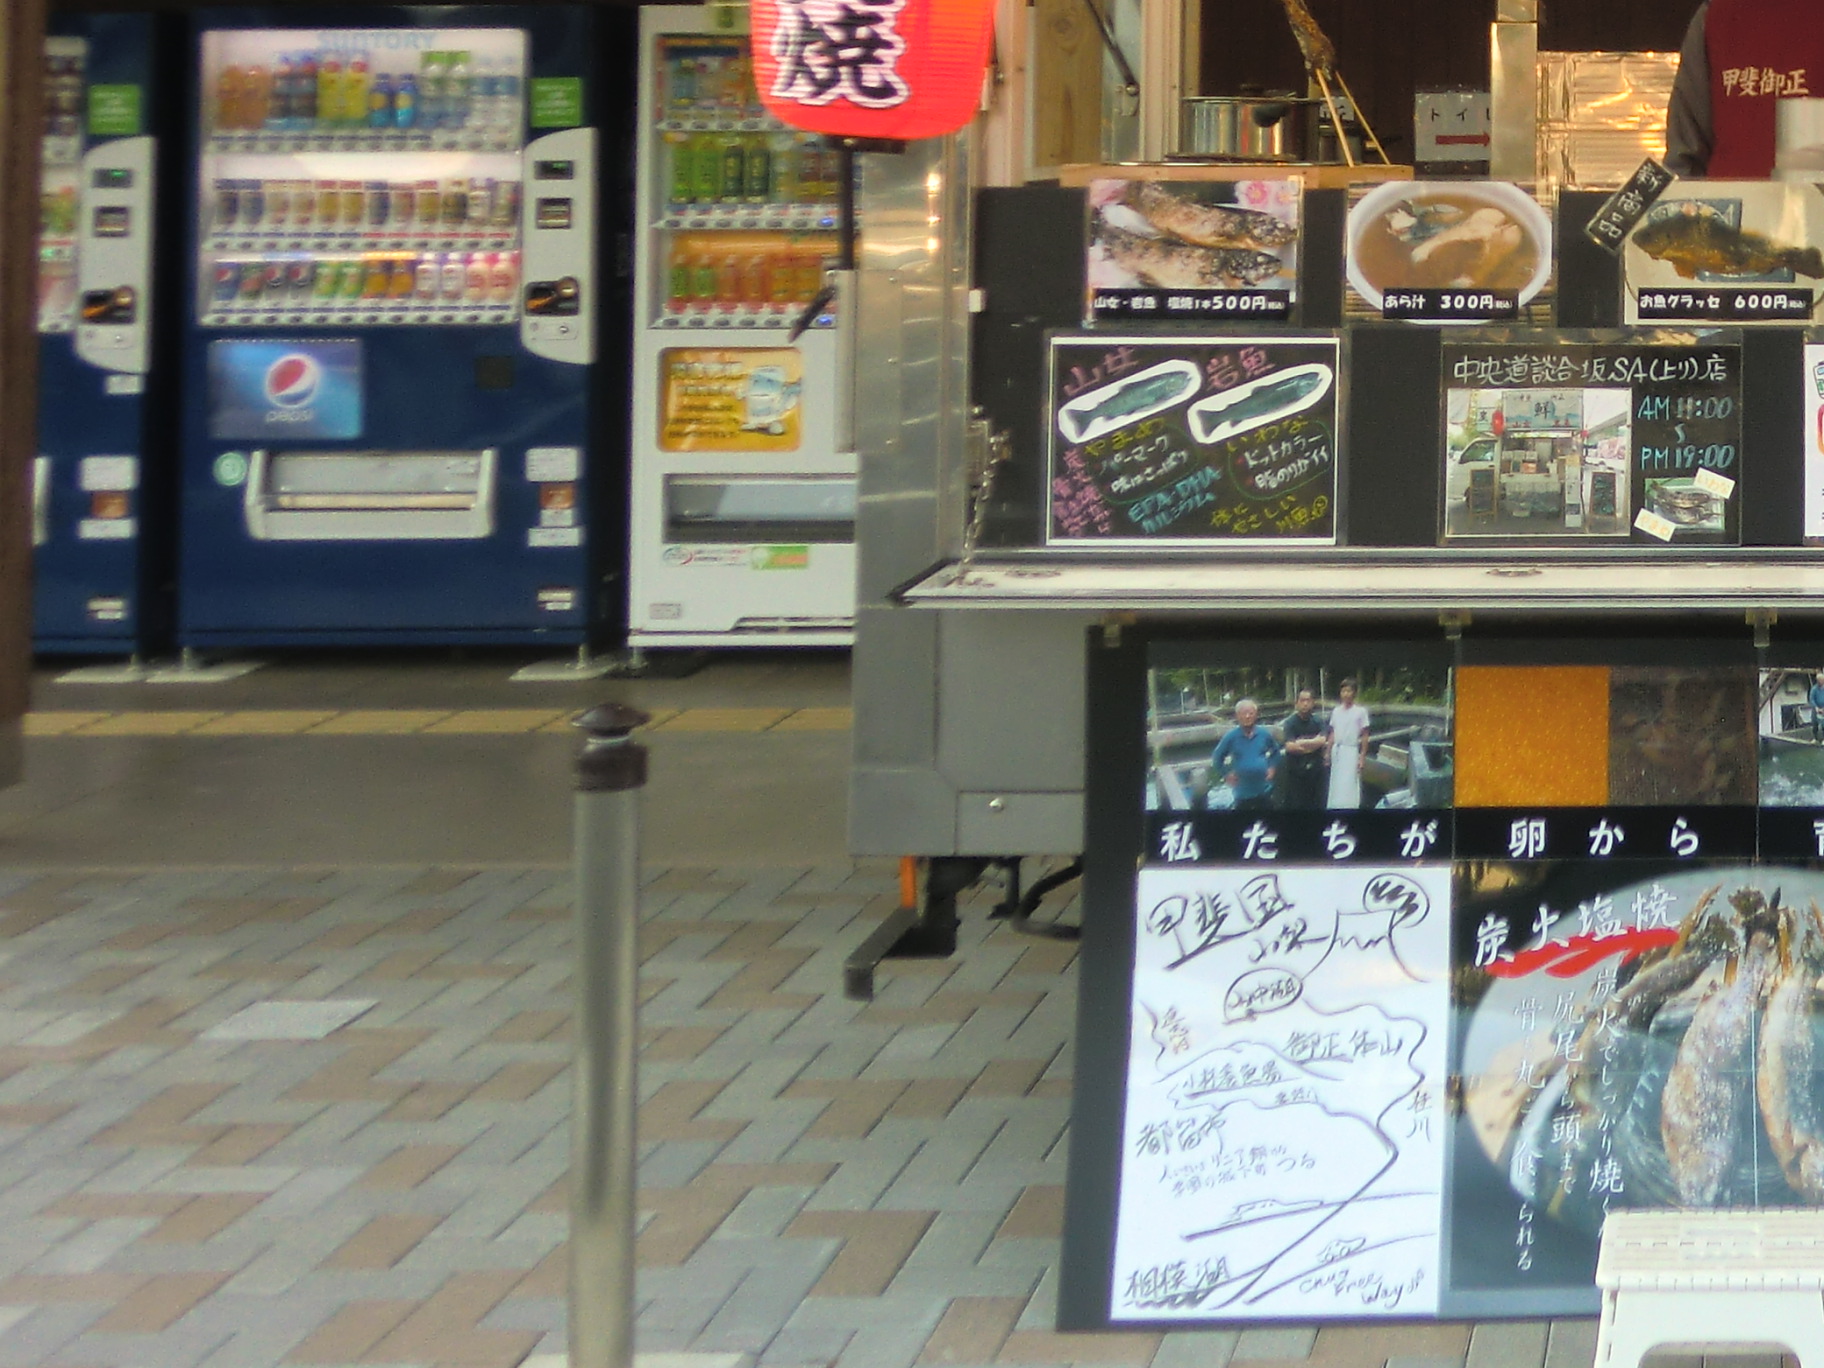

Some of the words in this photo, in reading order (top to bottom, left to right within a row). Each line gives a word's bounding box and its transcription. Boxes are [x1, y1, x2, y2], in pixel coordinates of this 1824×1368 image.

[1721, 66, 1809, 97] 甲斐御正
[1598, 163, 1663, 239] 新商品
[1384, 294, 1426, 310] あら汁
[1639, 294, 1721, 310] お魚グラッセ
[1206, 346, 1276, 391] 岩魚
[1637, 395, 1671, 421] AM
[1084, 417, 1166, 458] やまめ
[1226, 416, 1309, 454] いわな
[1640, 445, 1670, 470] PM
[1160, 819, 1438, 862] 私たちが
[1507, 819, 1702, 858] 卵から
[1473, 883, 1682, 968] 炭火塩焼
[1588, 962, 1625, 1237] 炭火でしっかり焼く
